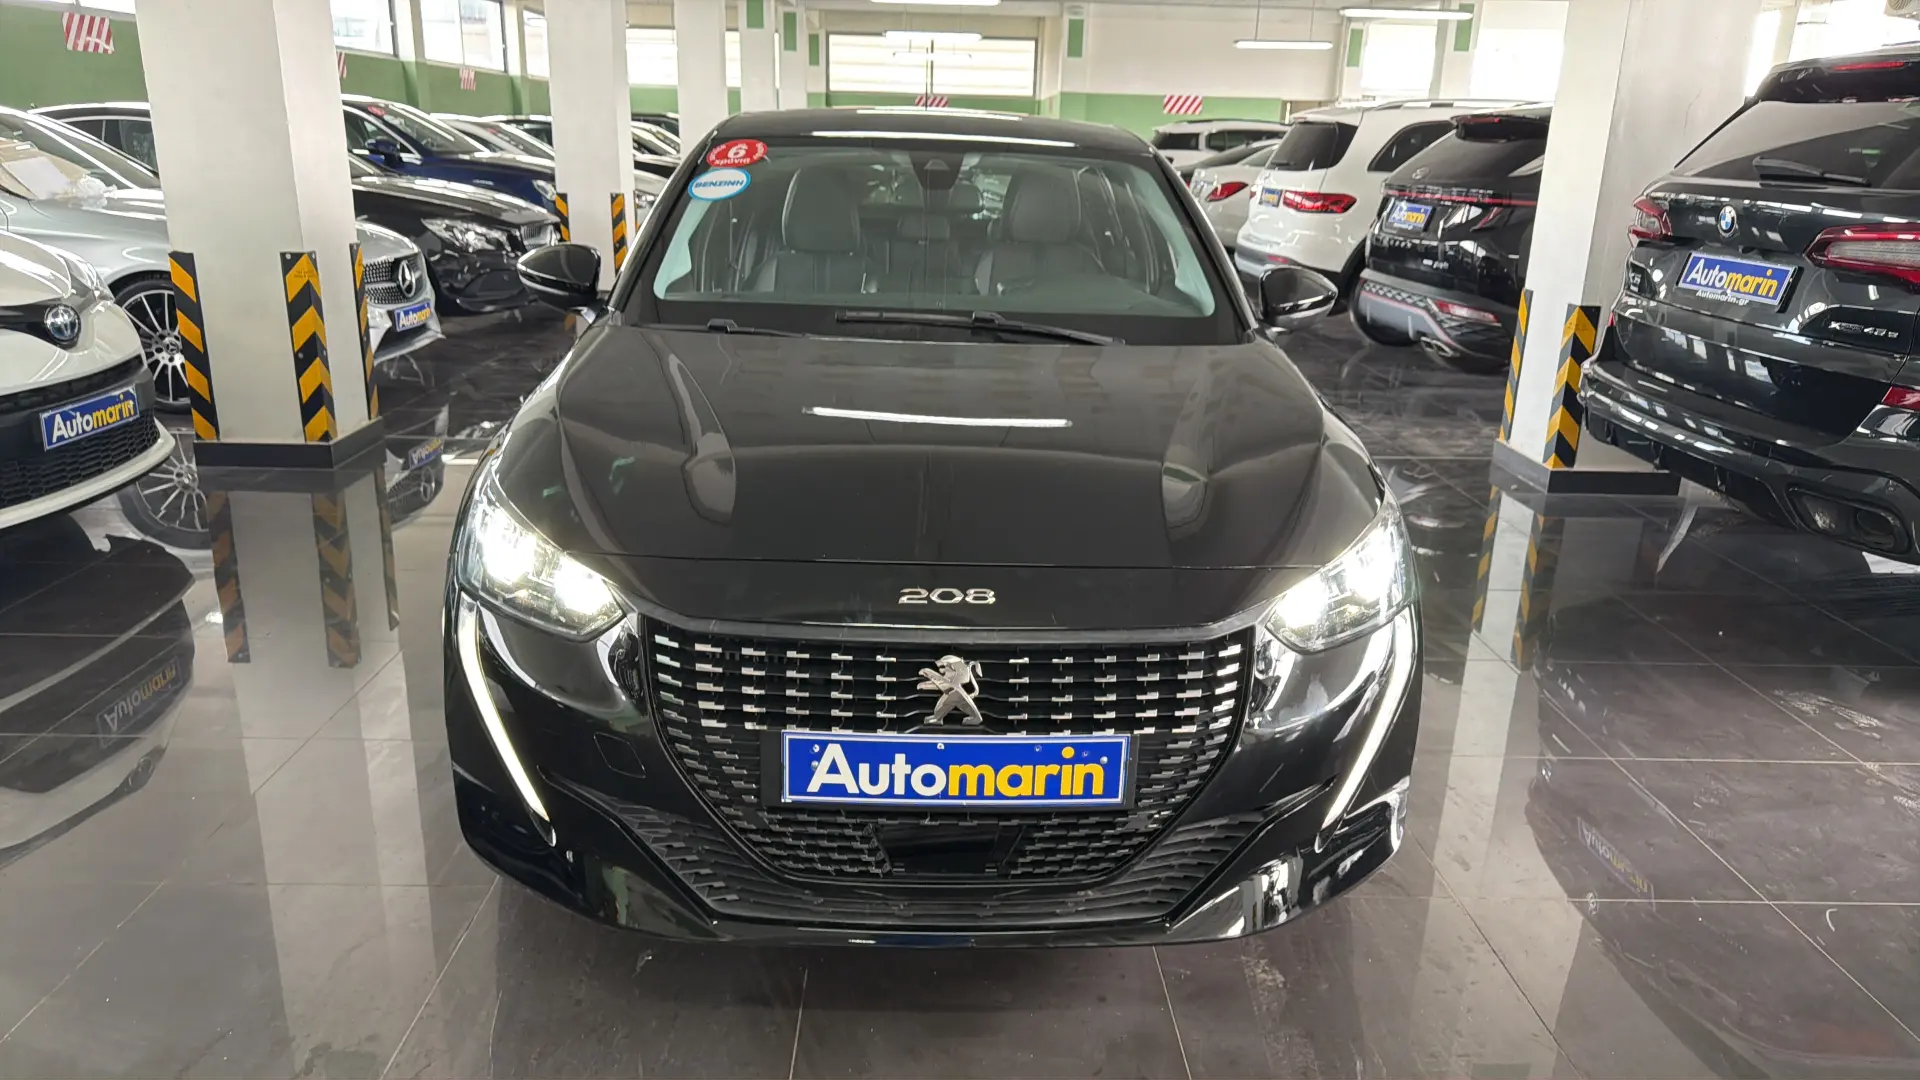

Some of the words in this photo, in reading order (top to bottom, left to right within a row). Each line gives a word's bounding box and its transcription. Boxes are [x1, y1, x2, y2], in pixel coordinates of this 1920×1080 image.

[727, 143, 748, 159] 6
[1686, 258, 1778, 298] Automarin
[52, 393, 135, 443] Automarin
[898, 588, 996, 605] 208
[806, 743, 1105, 797] Automarin
